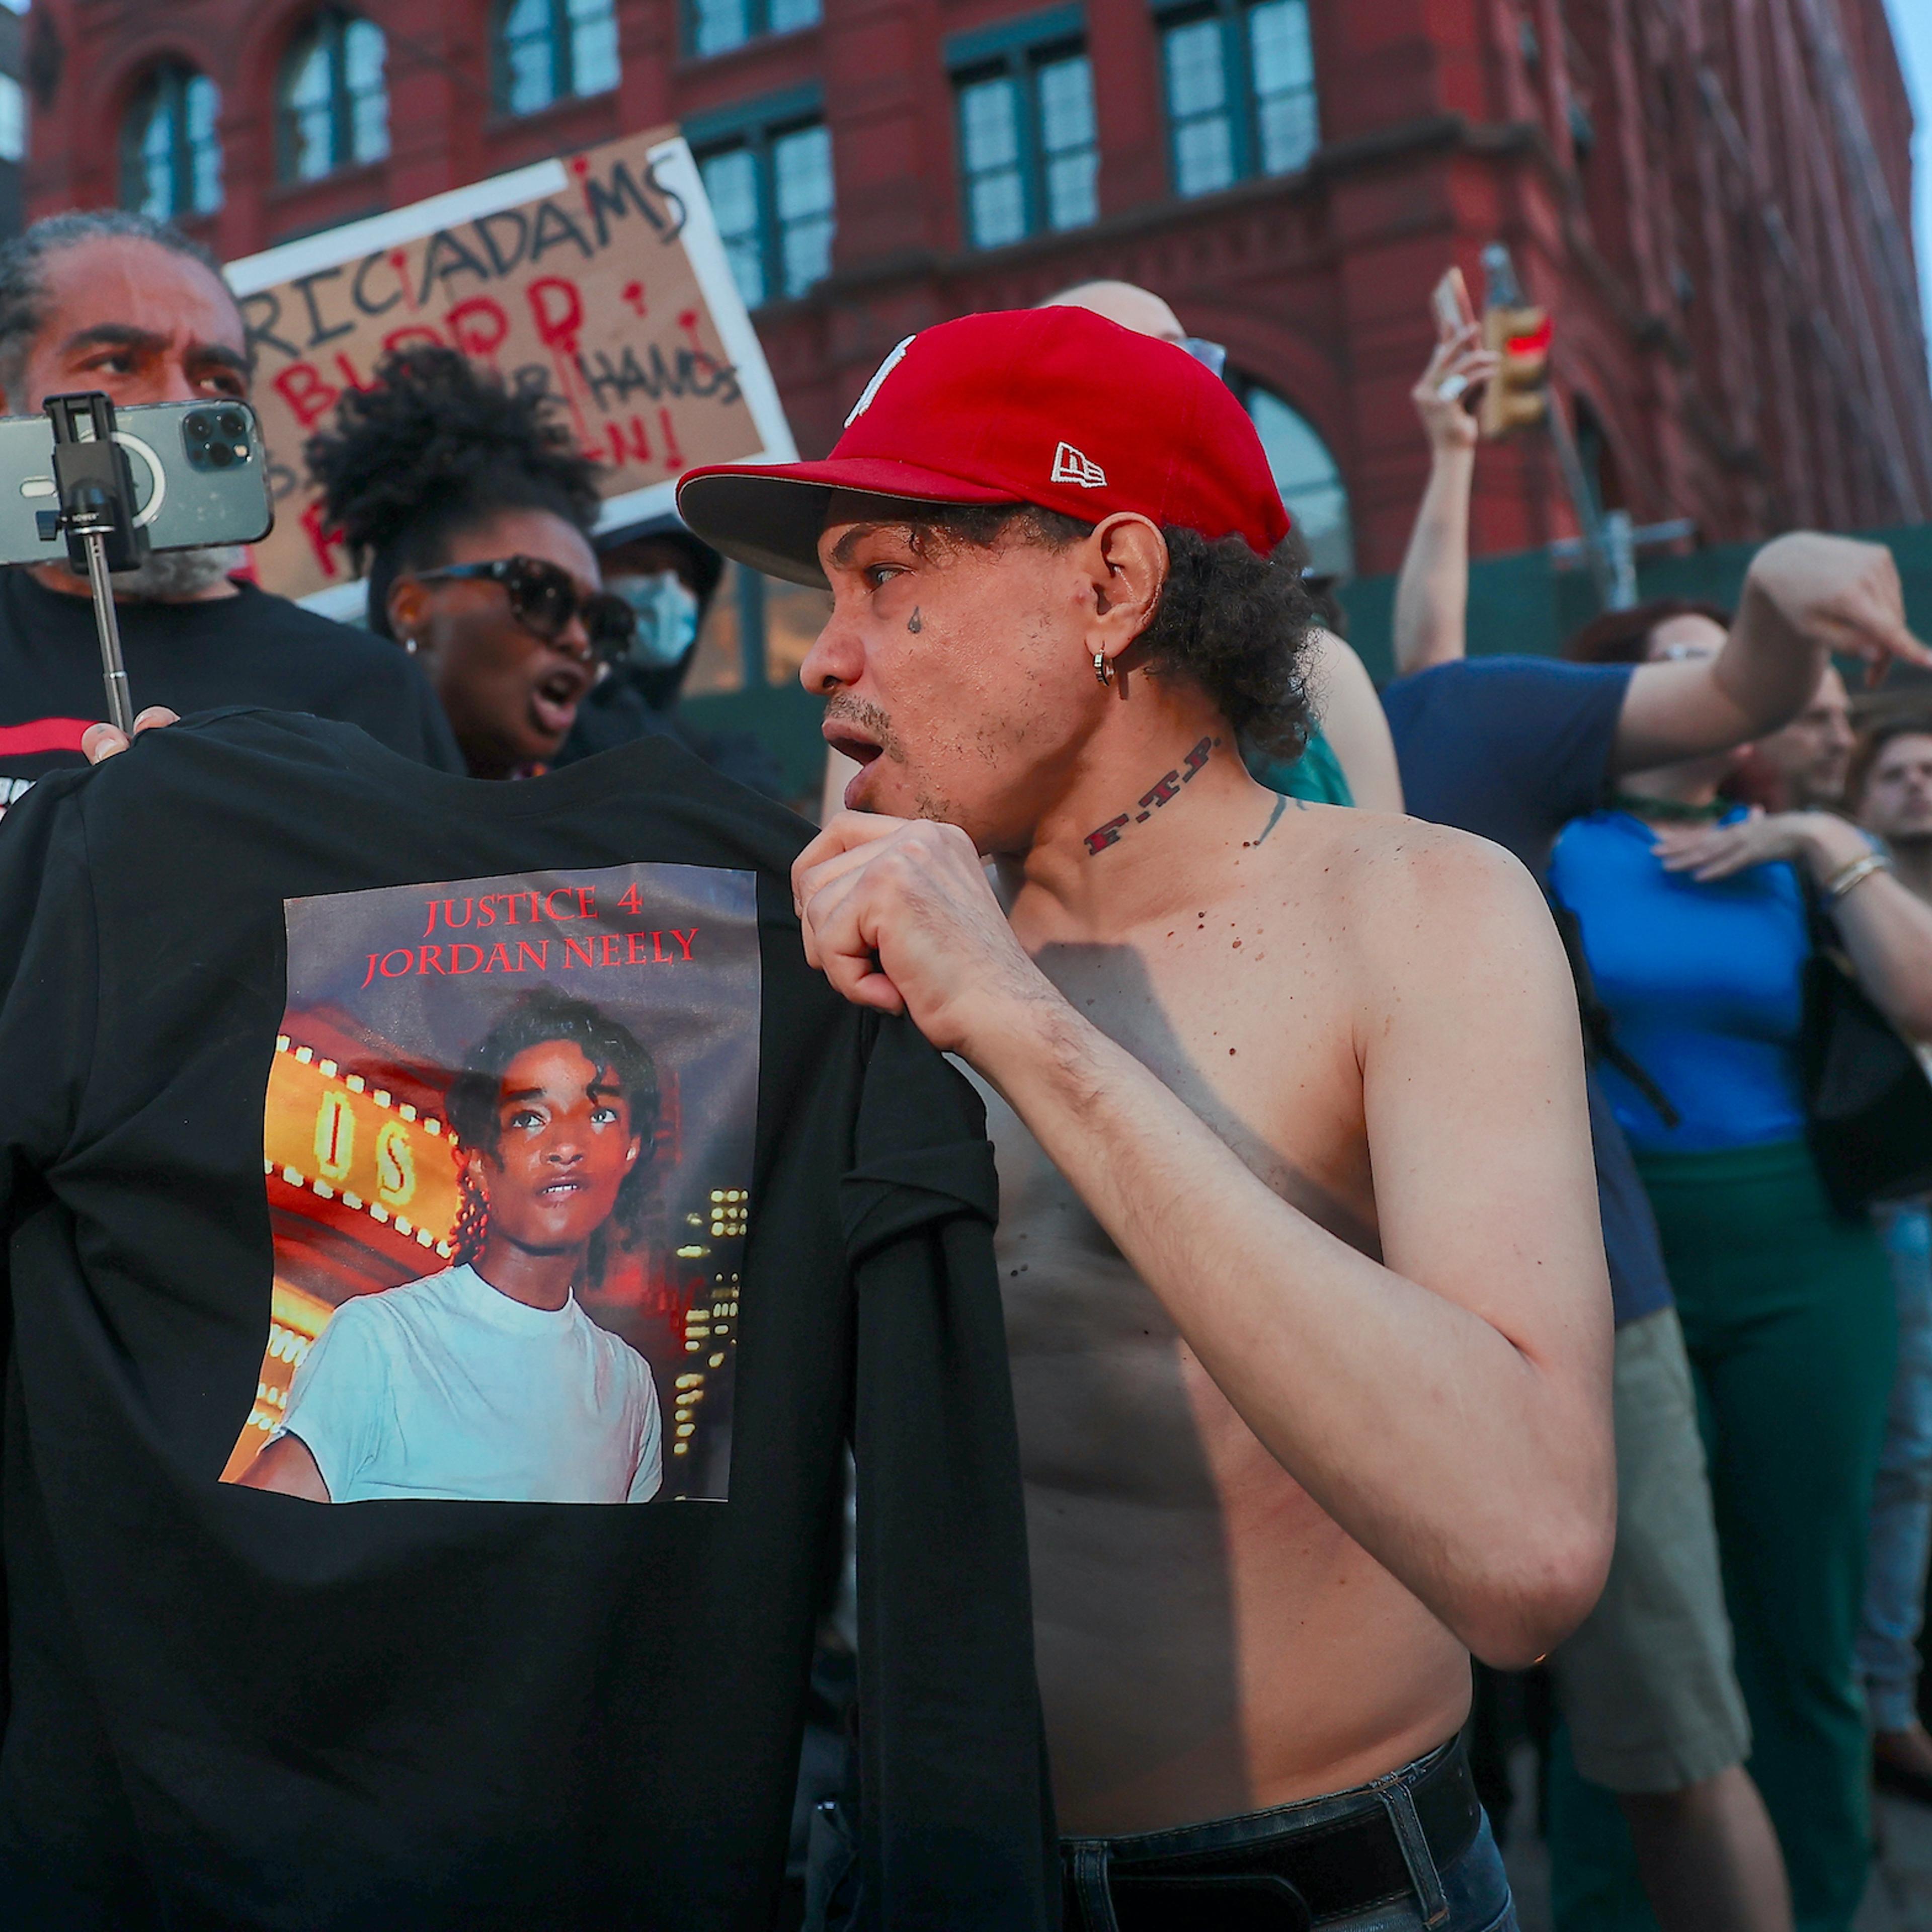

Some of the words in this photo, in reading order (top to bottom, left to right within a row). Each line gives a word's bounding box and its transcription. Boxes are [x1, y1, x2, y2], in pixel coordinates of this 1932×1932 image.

[240, 251, 401, 358] RIC
[418, 152, 688, 304] ADAMS
[423, 886, 598, 937] JUSTICE
[617, 882, 643, 915] 4
[360, 939, 549, 989] JORDAN
[562, 928, 699, 969] NEELY
